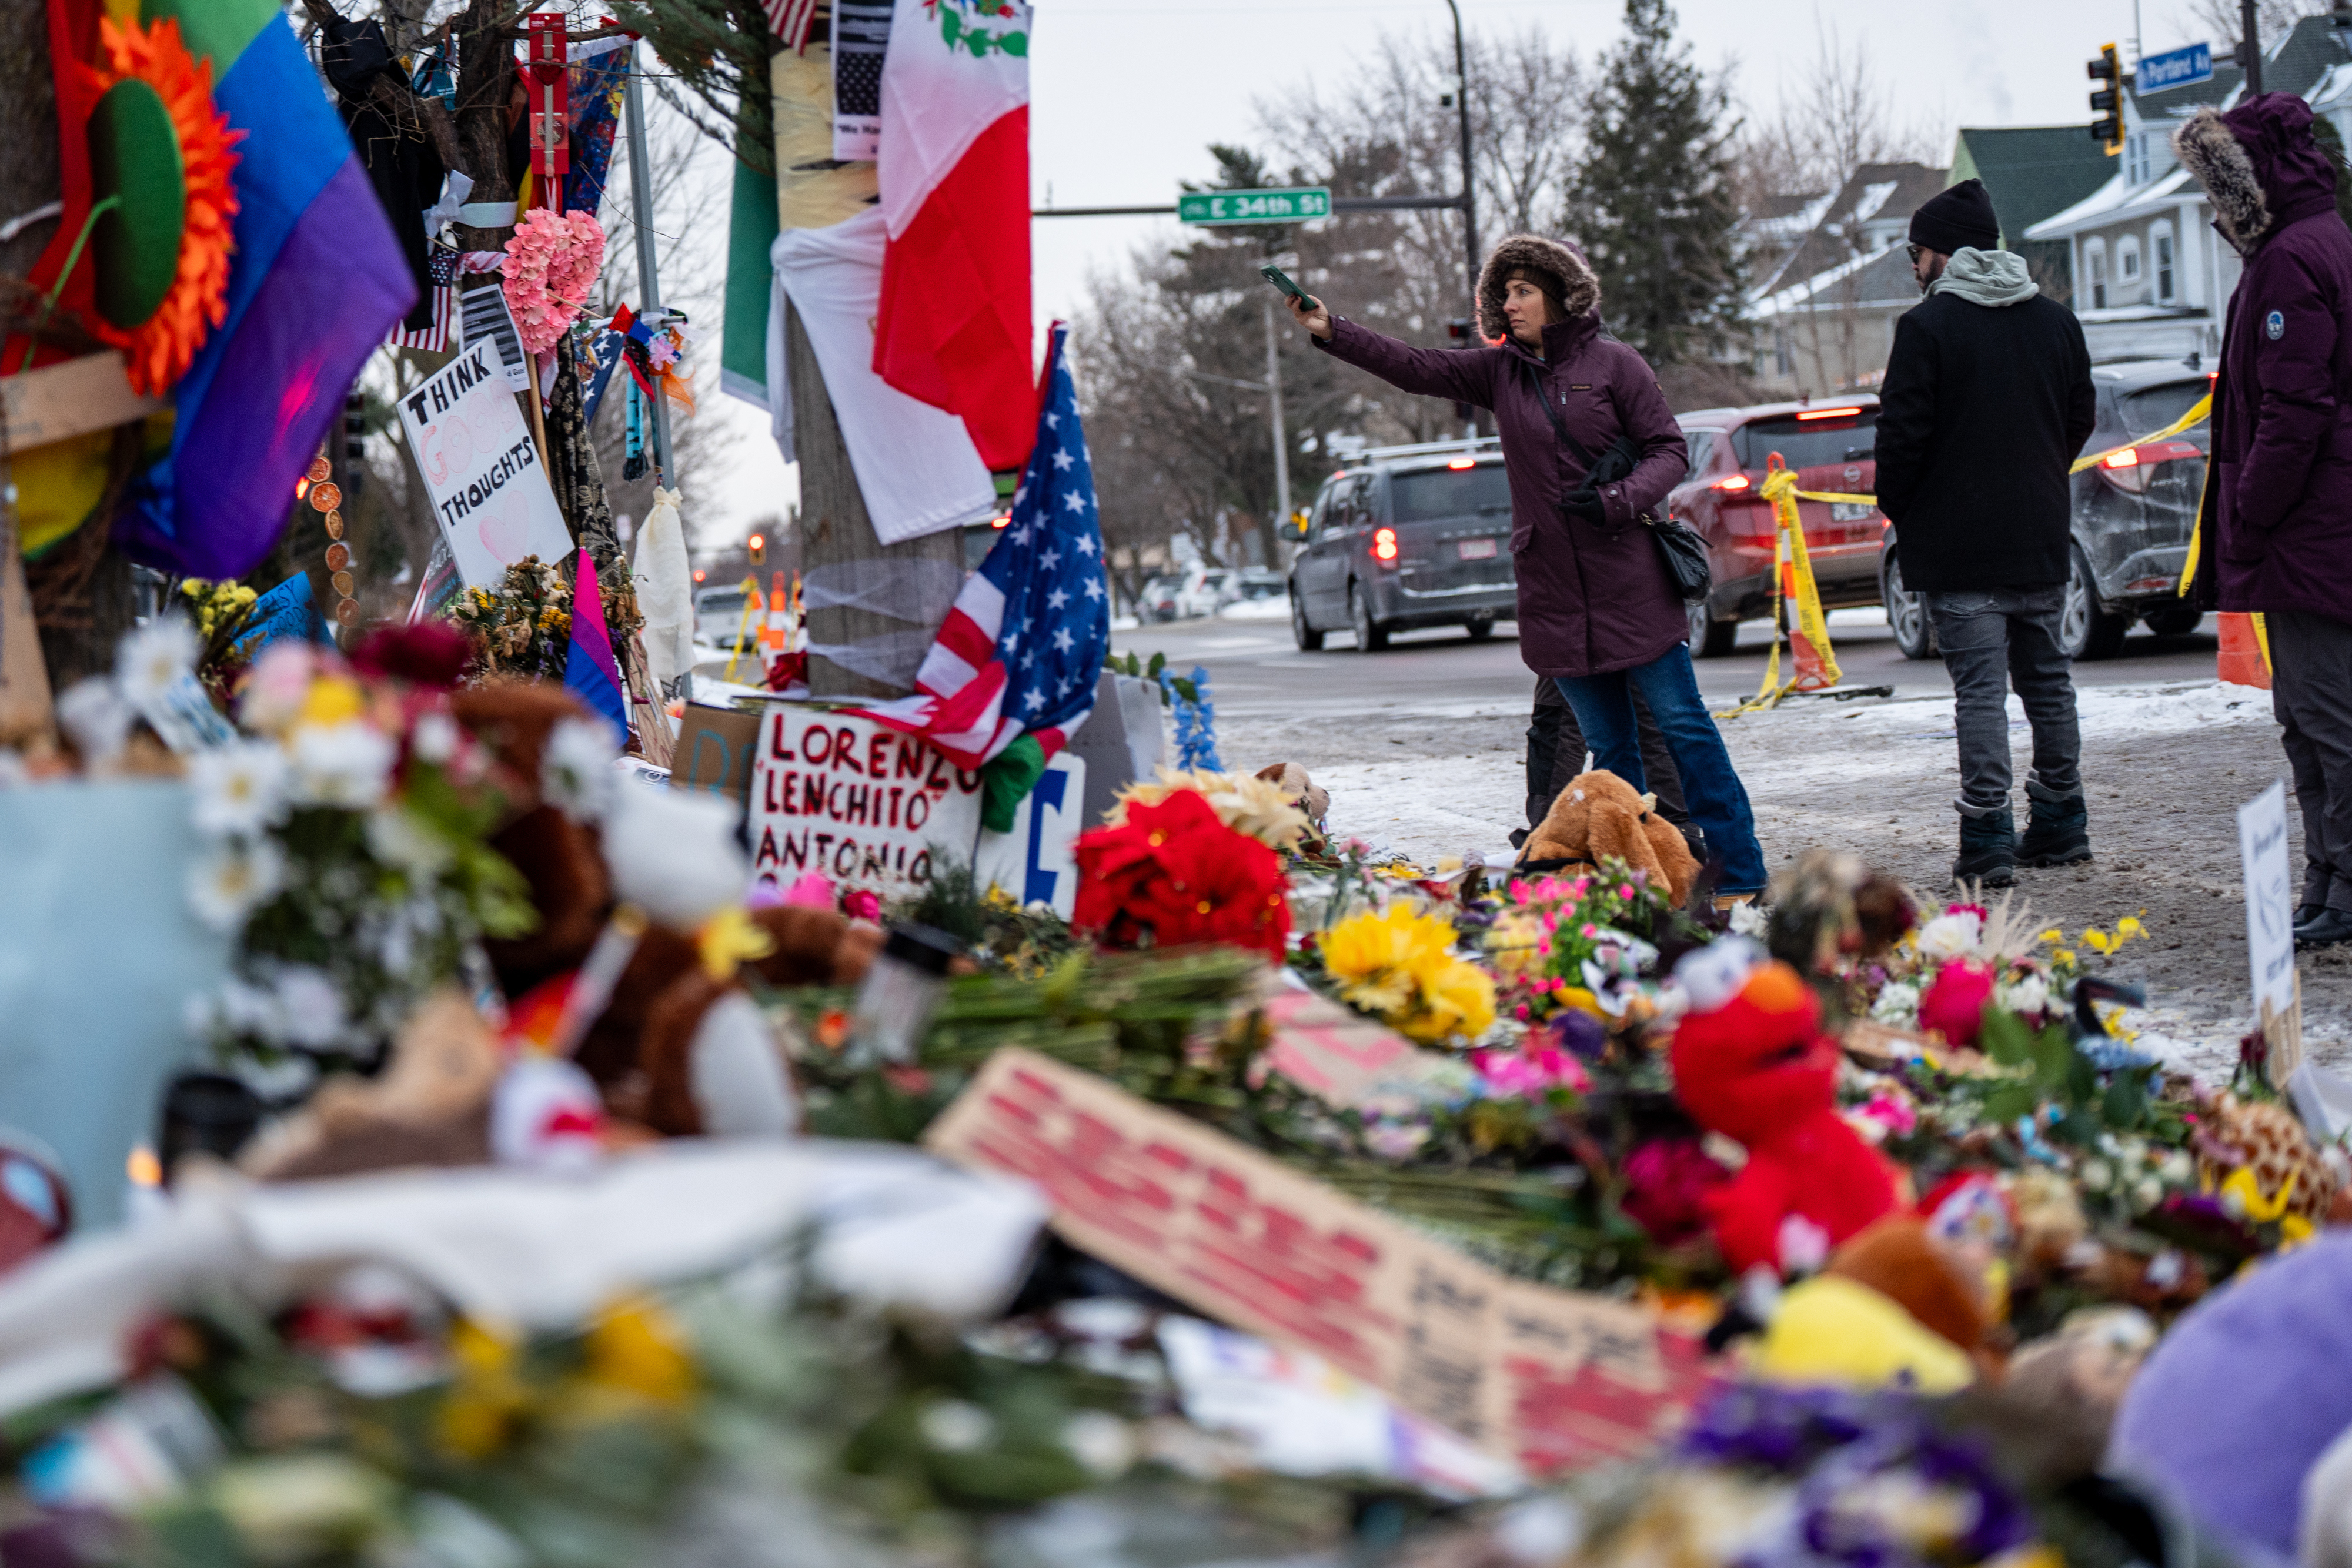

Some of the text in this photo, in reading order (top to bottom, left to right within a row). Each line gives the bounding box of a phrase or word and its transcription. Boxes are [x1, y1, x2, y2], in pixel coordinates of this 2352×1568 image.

[1210, 194, 1325, 218] E 34th St
[407, 347, 492, 426] THINK
[420, 380, 519, 486] GOOD
[440, 436, 534, 527] THOUGHTS
[756, 824, 933, 886] ANTONIO
